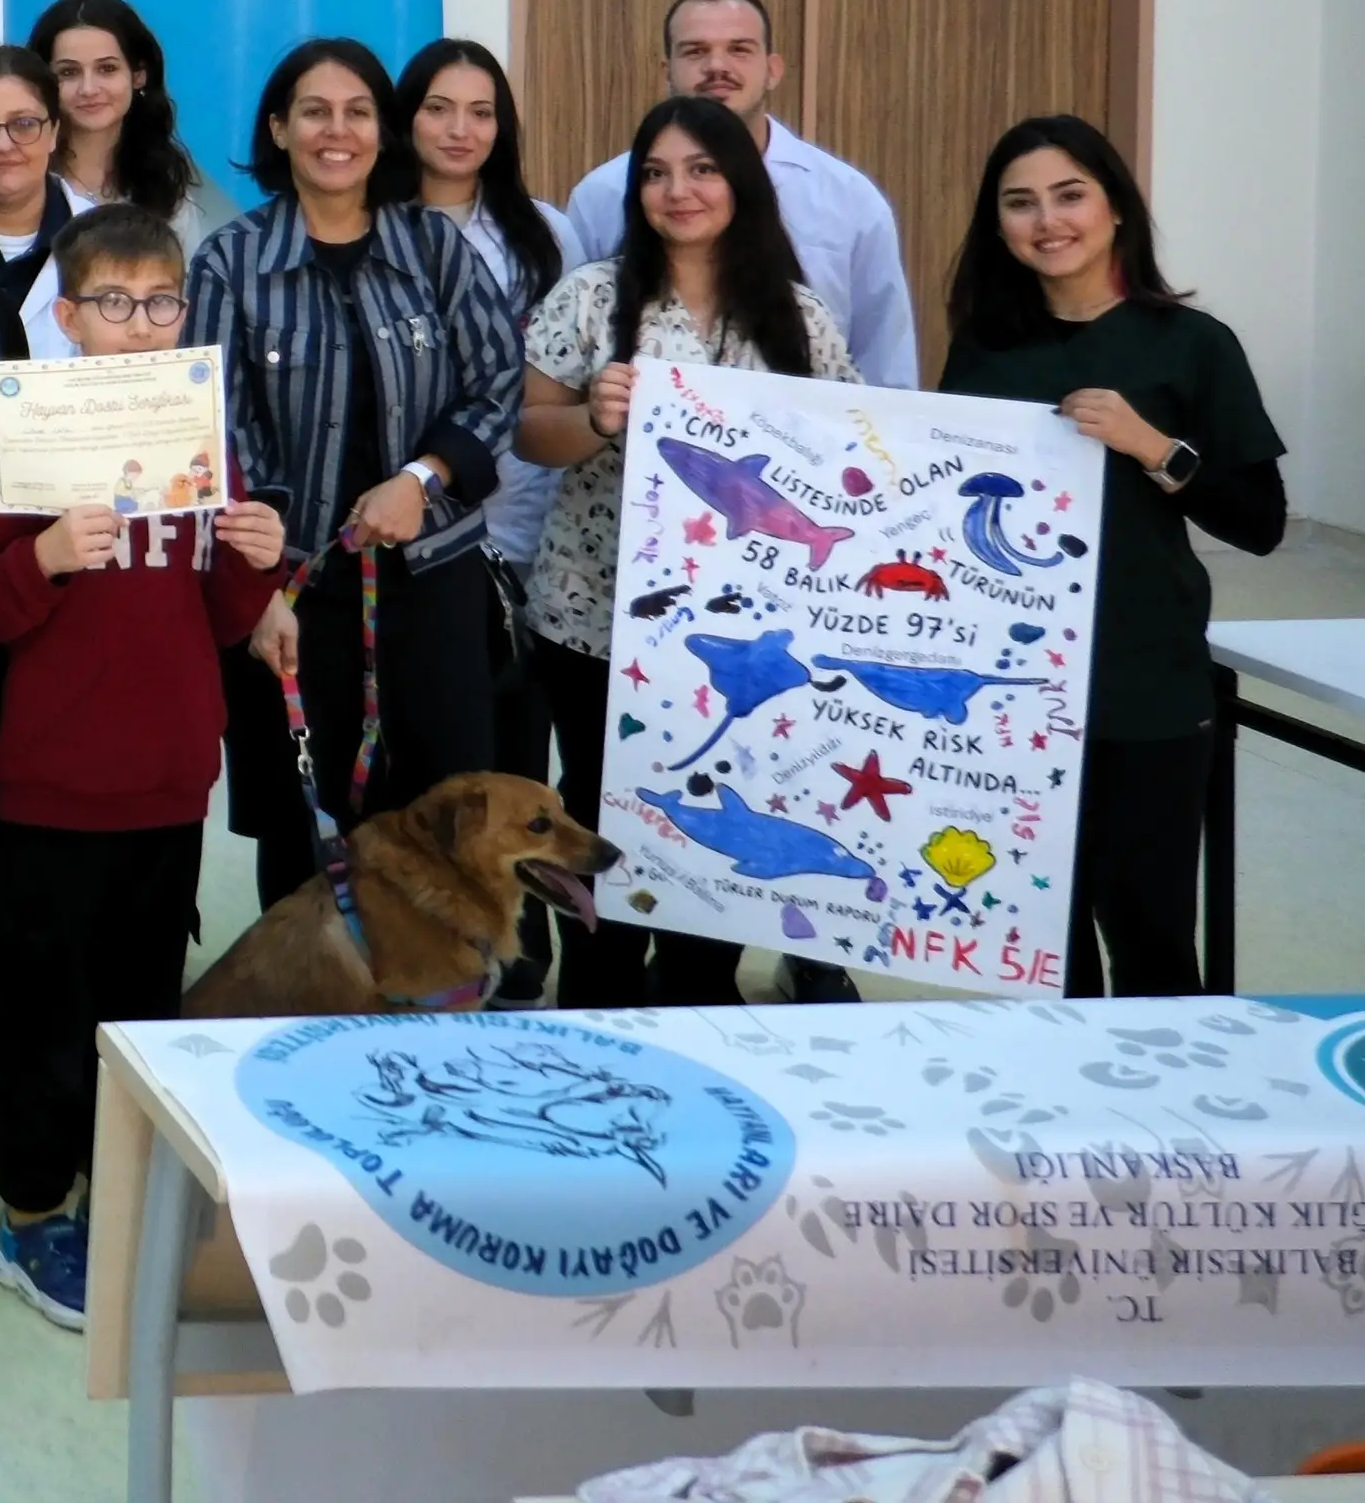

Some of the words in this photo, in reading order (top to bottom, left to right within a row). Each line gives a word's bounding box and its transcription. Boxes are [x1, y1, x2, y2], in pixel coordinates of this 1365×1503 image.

[770, 465, 888, 516] LİSTESİNDE
[900, 455, 964, 496] OLAN
[741, 539, 780, 571] 58
[785, 567, 850, 593] BALIK
[949, 559, 1056, 612] TÜRÜNÜN
[807, 605, 889, 635] YÜZDE
[813, 699, 905, 742] YÜKSEK
[922, 725, 984, 755] RİSK
[713, 877, 764, 900] TÜRLER
[825, 902, 881, 924] RAPORU
[891, 927, 984, 976] NFK
[1016, 1150, 1242, 1183] BAŞKANLIĞI
[693, 1195, 732, 1243] VE
[843, 1199, 957, 1231] DAİRE
[972, 1199, 1060, 1229] SPOR
[1070, 1200, 1112, 1229] VE
[1130, 1199, 1276, 1233] KÜLTÜR
[1287, 1199, 1365, 1233] ĞLIK
[408, 1188, 547, 1277] KORUMA
[558, 1230, 685, 1281] DOĞAYI
[909, 1248, 1157, 1282] ÜNİVERSİTESİ
[1171, 1247, 1357, 1277] BALIKESİR
